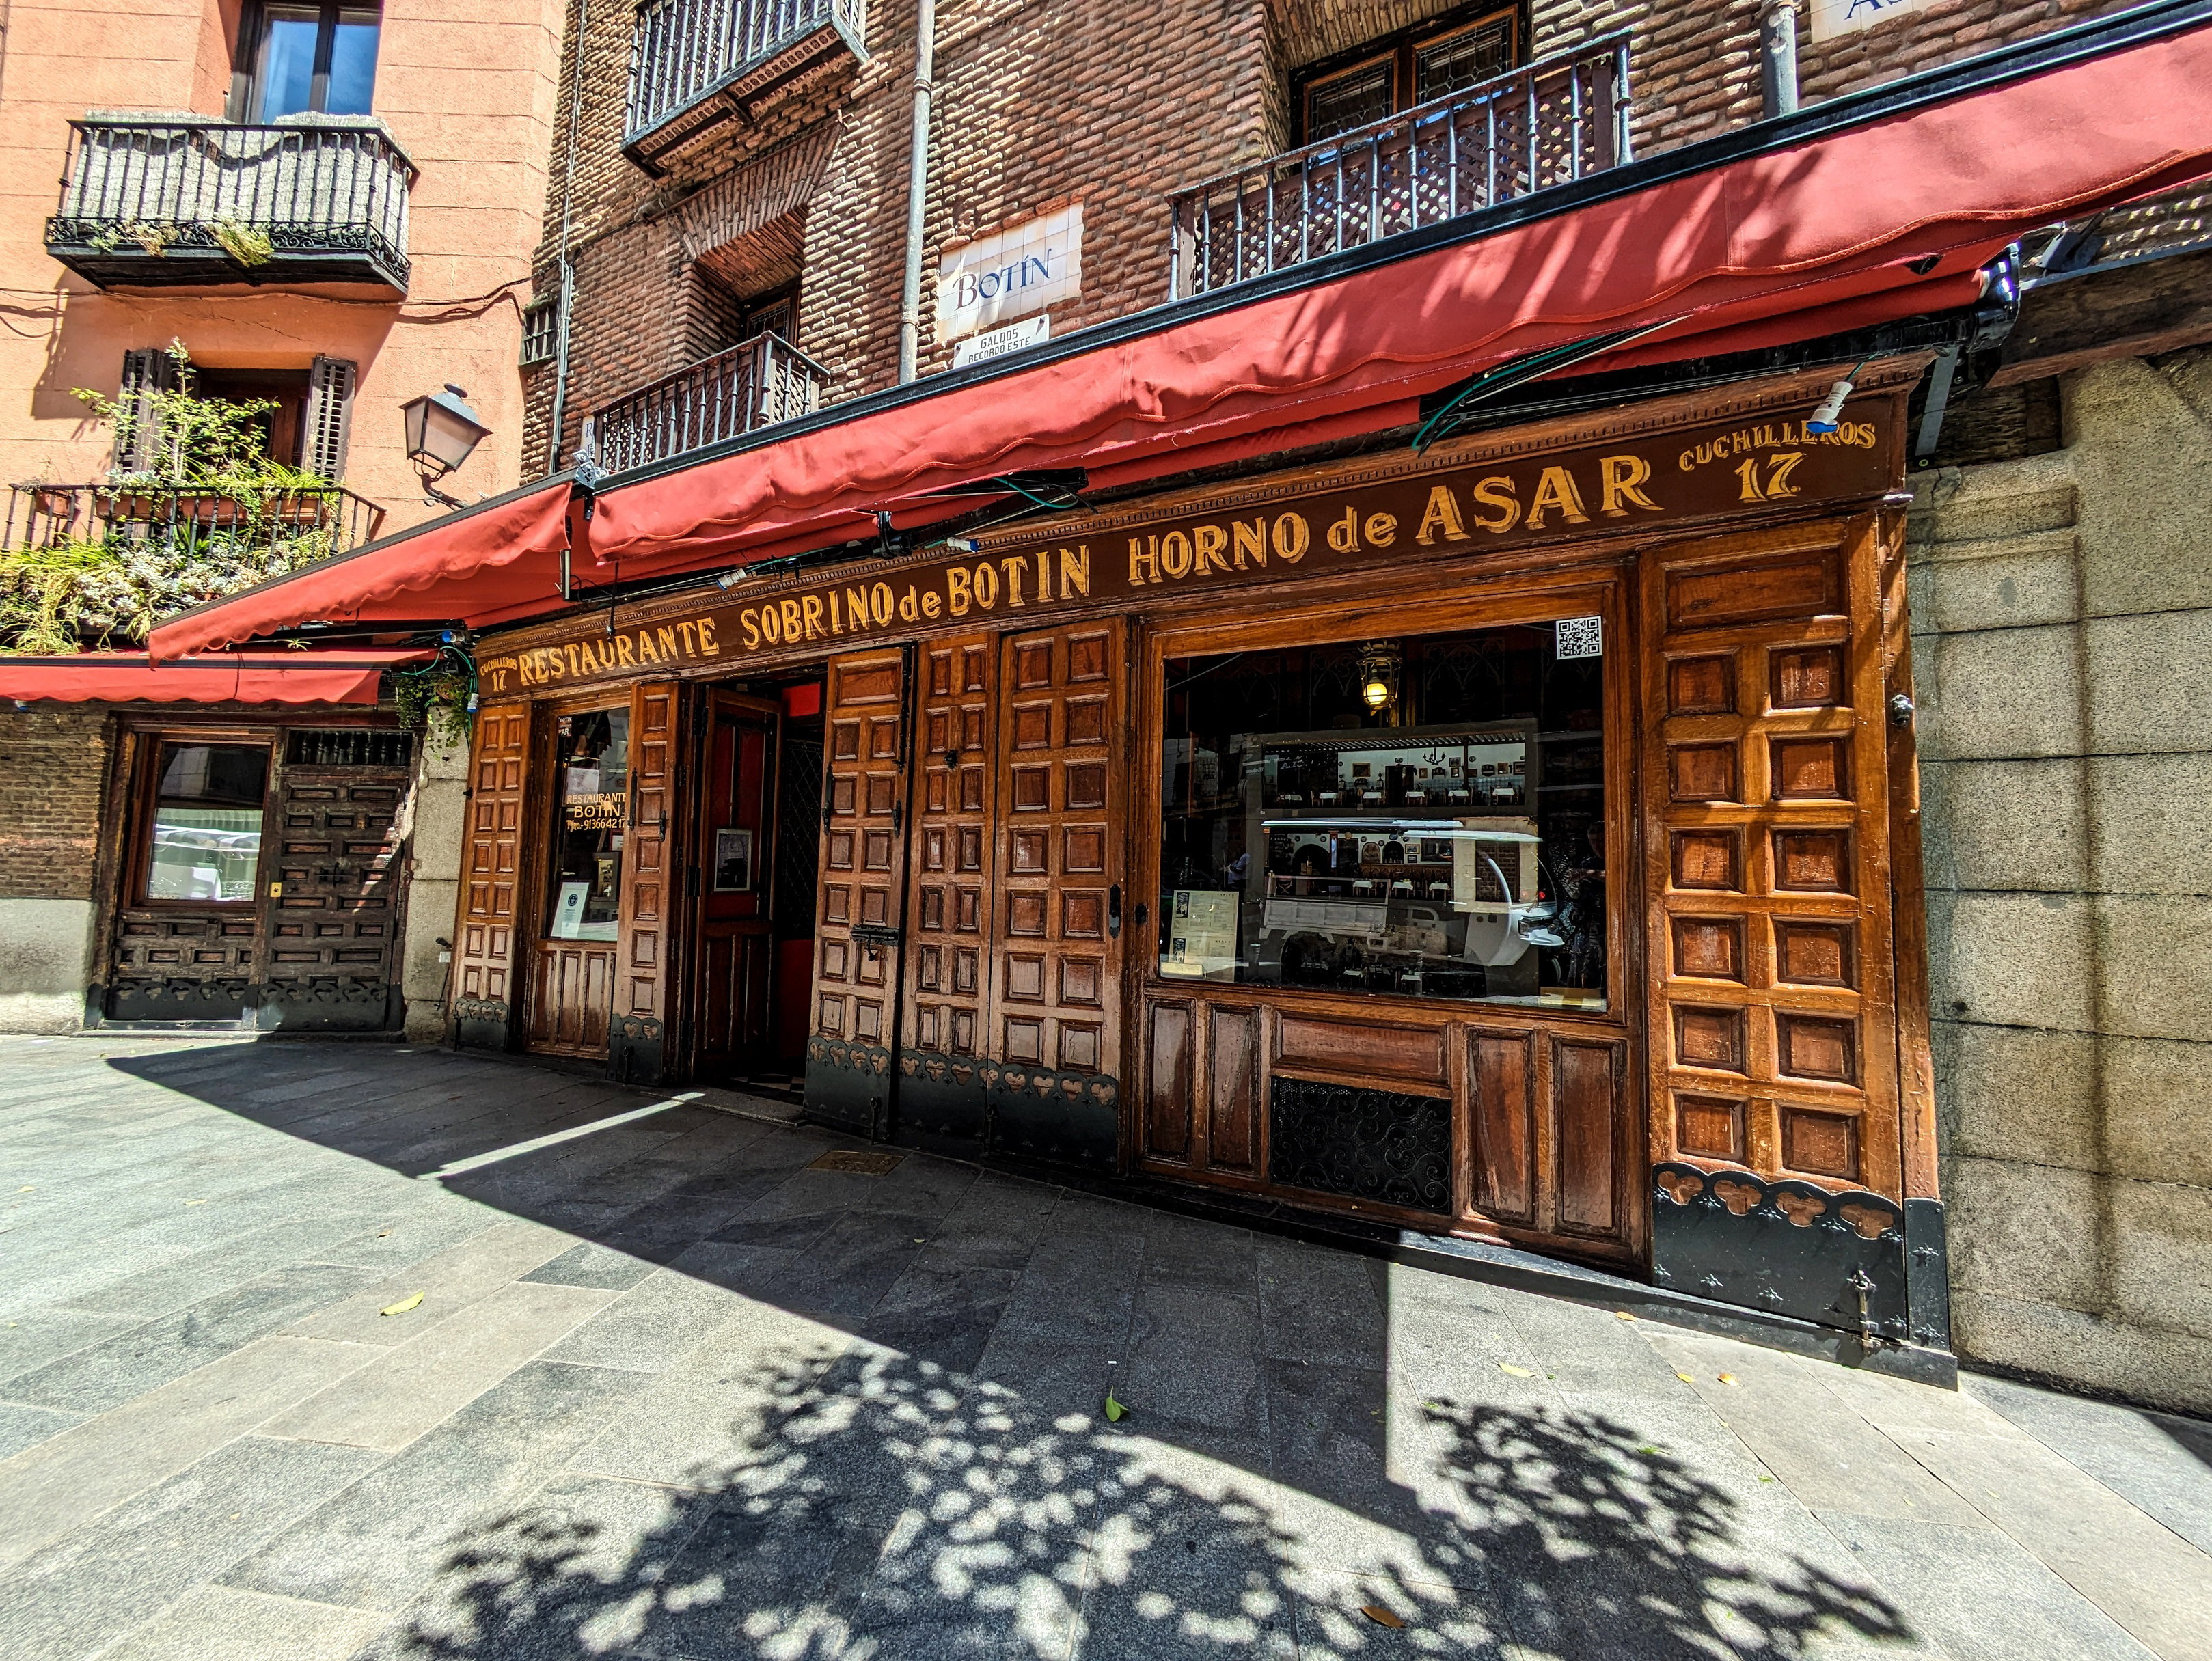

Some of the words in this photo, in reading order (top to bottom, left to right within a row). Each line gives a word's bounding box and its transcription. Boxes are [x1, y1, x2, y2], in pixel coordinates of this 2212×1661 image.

[953, 249, 1052, 311] BOTÍN
[968, 342, 1005, 363] RECORDÓ
[1007, 337, 1030, 351] ESTE
[981, 328, 1018, 349] GALDOS
[519, 616, 719, 686] RESTAURANTE
[741, 581, 893, 650] SOBRINO
[899, 584, 941, 622] de
[946, 545, 1089, 617] BOTIN
[1127, 512, 1310, 587] HORNO
[1326, 506, 1397, 554] de
[1415, 454, 1665, 545] ASAR
[566, 793, 626, 804] RESTAURANTE
